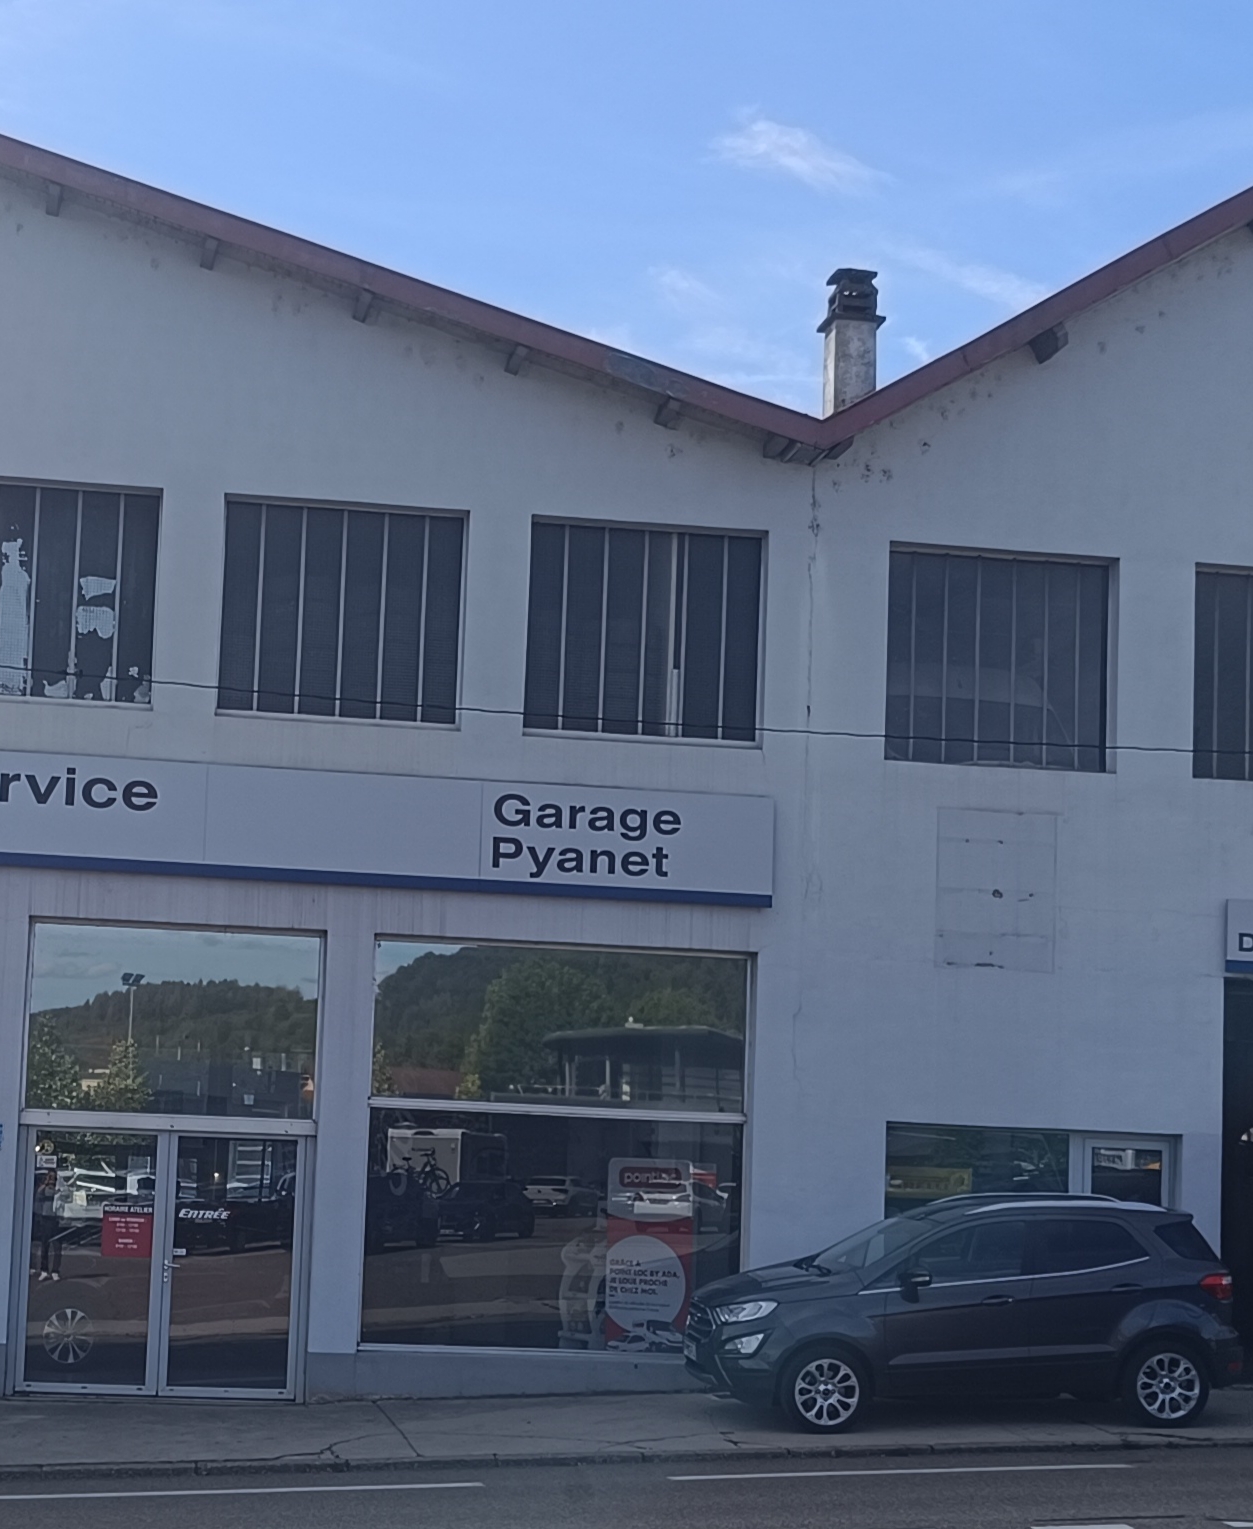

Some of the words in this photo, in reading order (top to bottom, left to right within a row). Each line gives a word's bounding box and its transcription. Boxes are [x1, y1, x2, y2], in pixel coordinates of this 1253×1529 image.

[493, 793, 682, 841] Garage
[491, 836, 669, 878] Pyanet
[619, 1277, 637, 1285] LOUE
[639, 1278, 668, 1287] PROCHE
